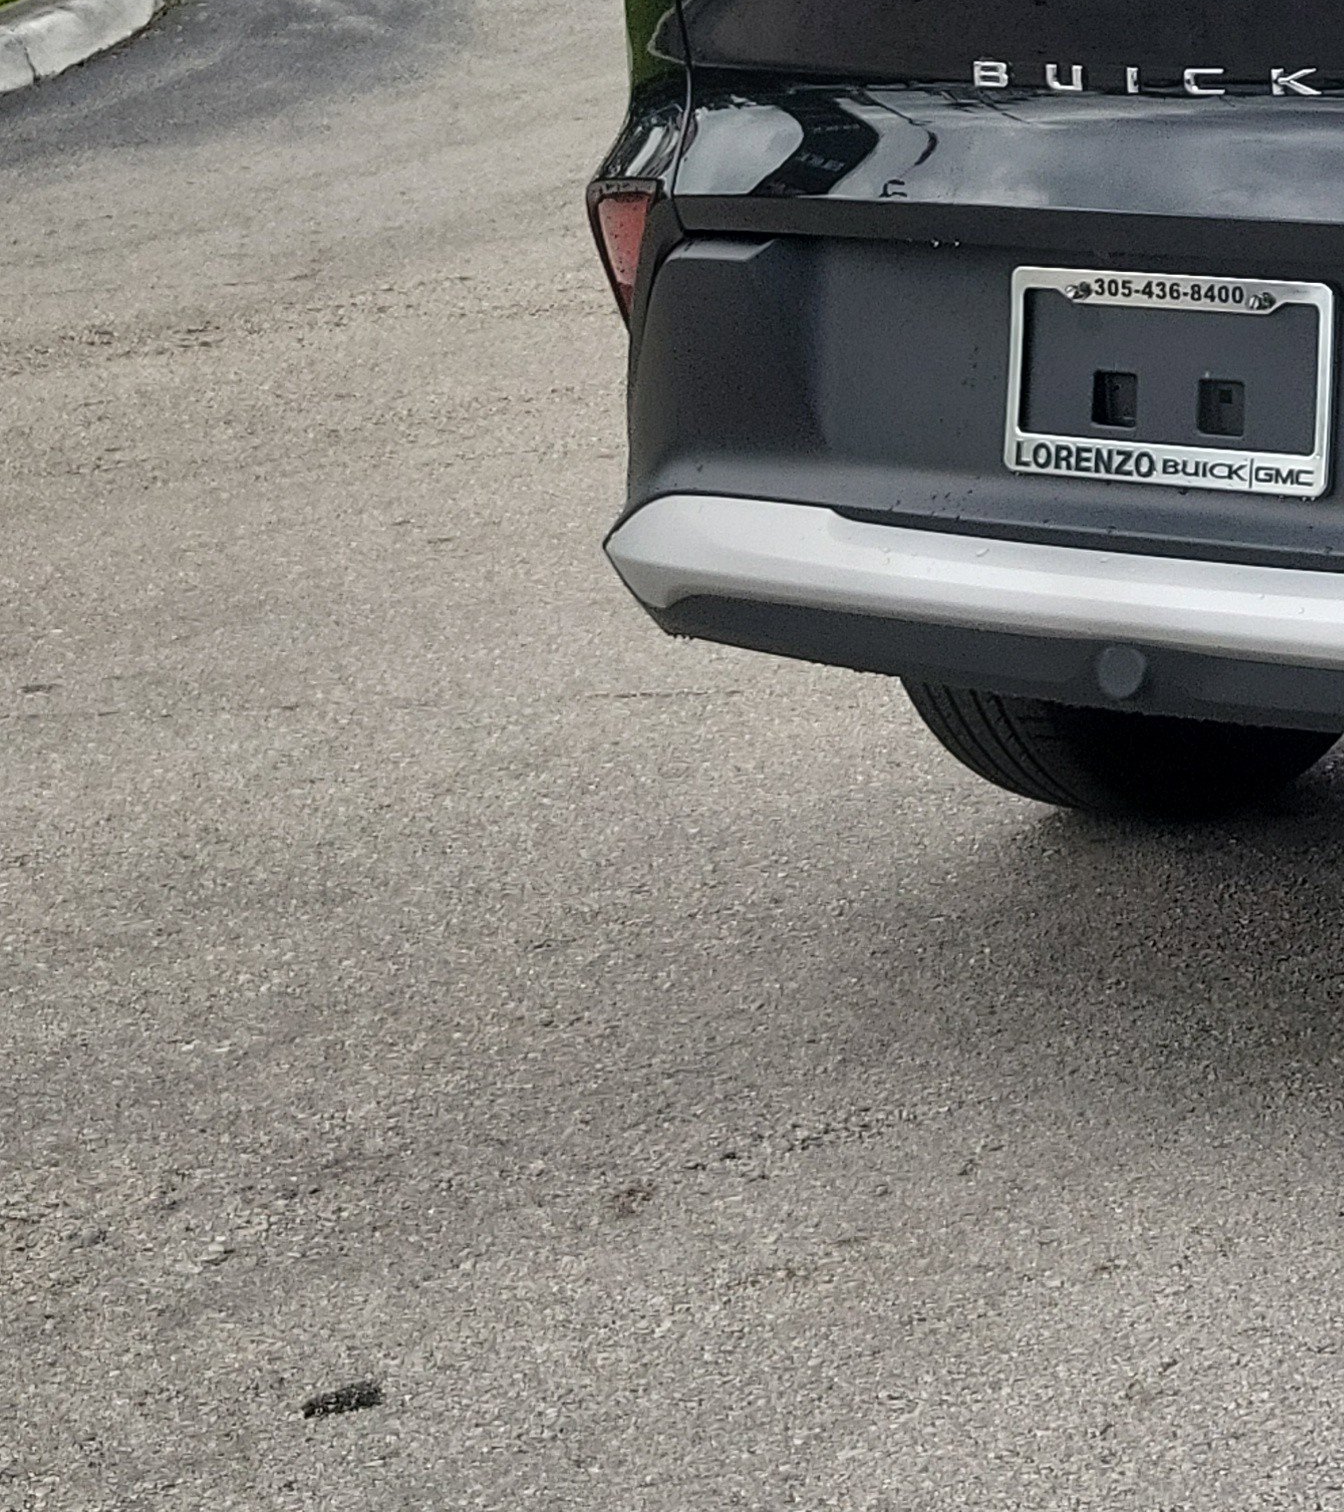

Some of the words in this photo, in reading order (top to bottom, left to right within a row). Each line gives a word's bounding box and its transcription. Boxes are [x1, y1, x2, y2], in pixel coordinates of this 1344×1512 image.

[972, 59, 1322, 96] BUICK
[1093, 278, 1245, 305] 305-436-8400
[1014, 441, 1156, 479] LORENZO
[1161, 459, 1248, 481] BUICK
[1254, 465, 1316, 487] GMC
